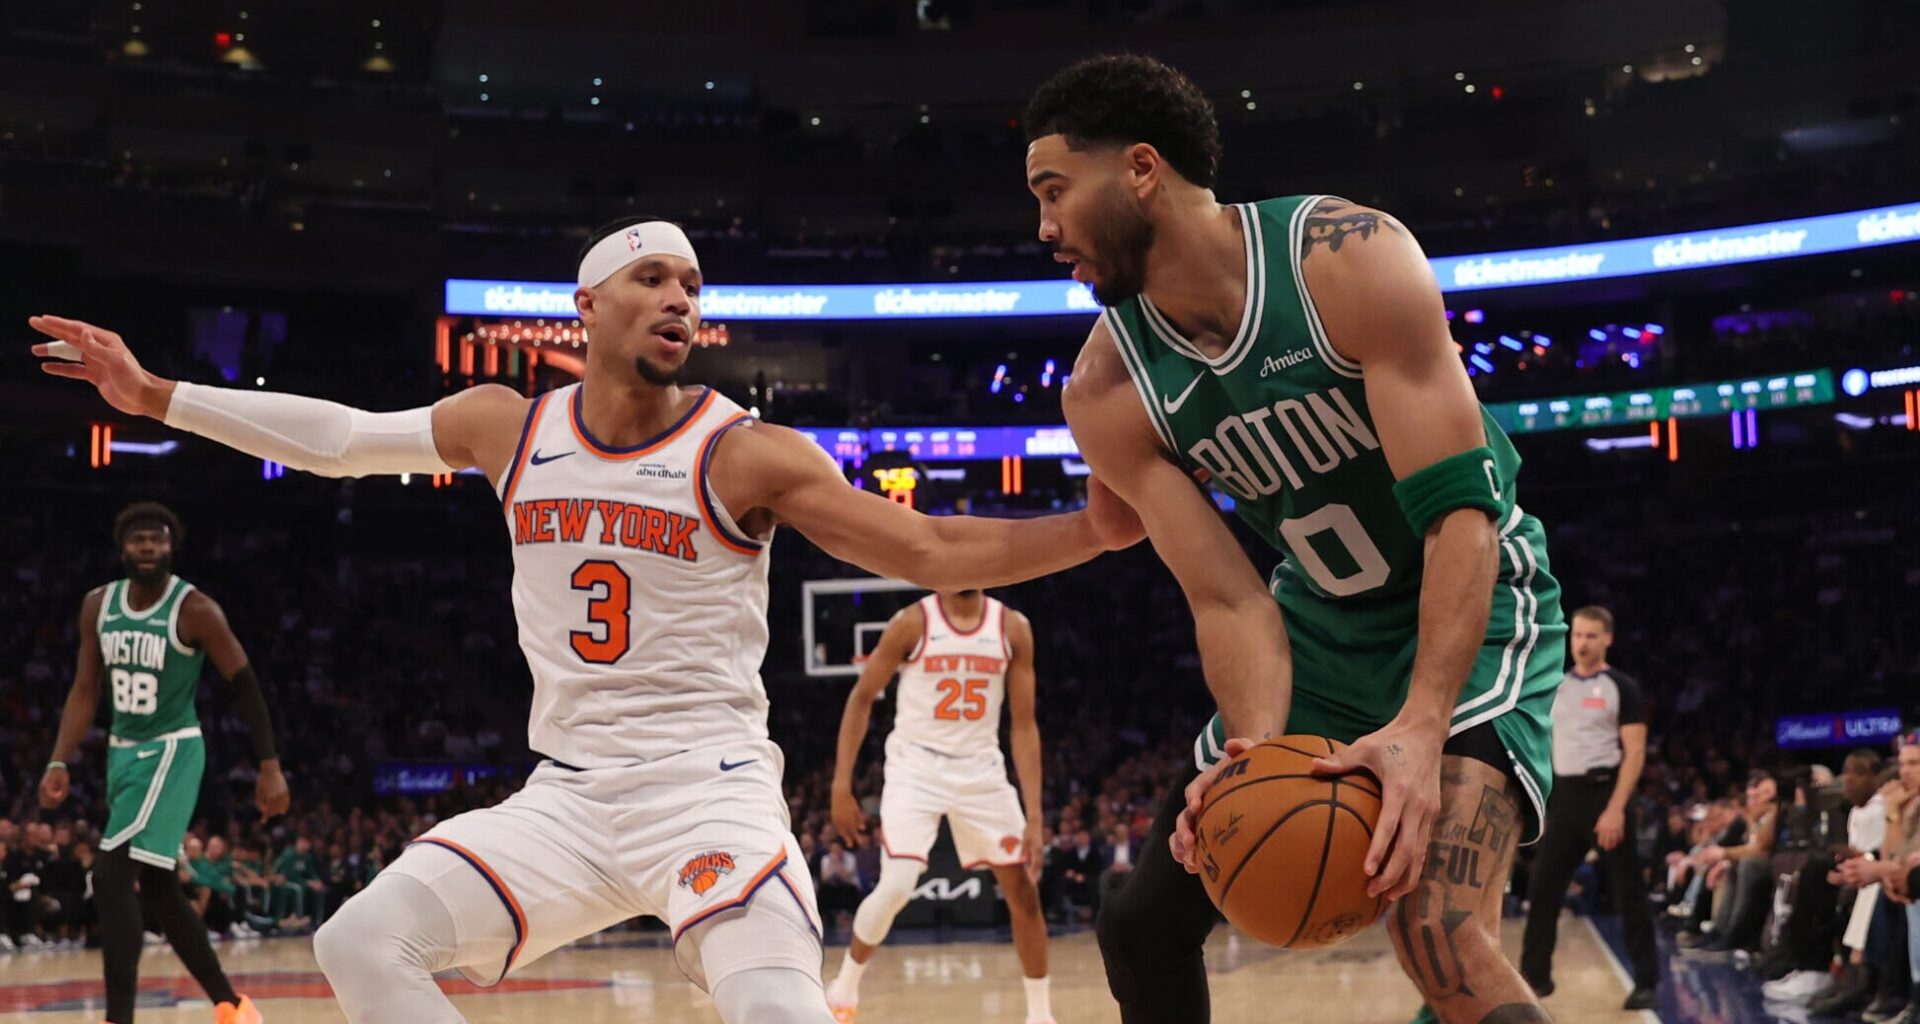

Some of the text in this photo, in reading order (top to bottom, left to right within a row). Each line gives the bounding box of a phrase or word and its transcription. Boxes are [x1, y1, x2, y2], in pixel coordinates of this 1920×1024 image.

[1652, 229, 1807, 267] ticketmaster
[1453, 252, 1604, 286] ticketmaster
[484, 286, 577, 312] ticketm
[874, 289, 1020, 314] ticketmaster
[1260, 347, 1314, 378] Amica
[514, 499, 699, 562] NEW YORK
[1279, 503, 1391, 597] 0
[570, 559, 631, 665] 3
[101, 630, 167, 672] BOSTON
[924, 656, 959, 673] NEW
[111, 668, 159, 715] 88
[934, 678, 989, 720] 25
